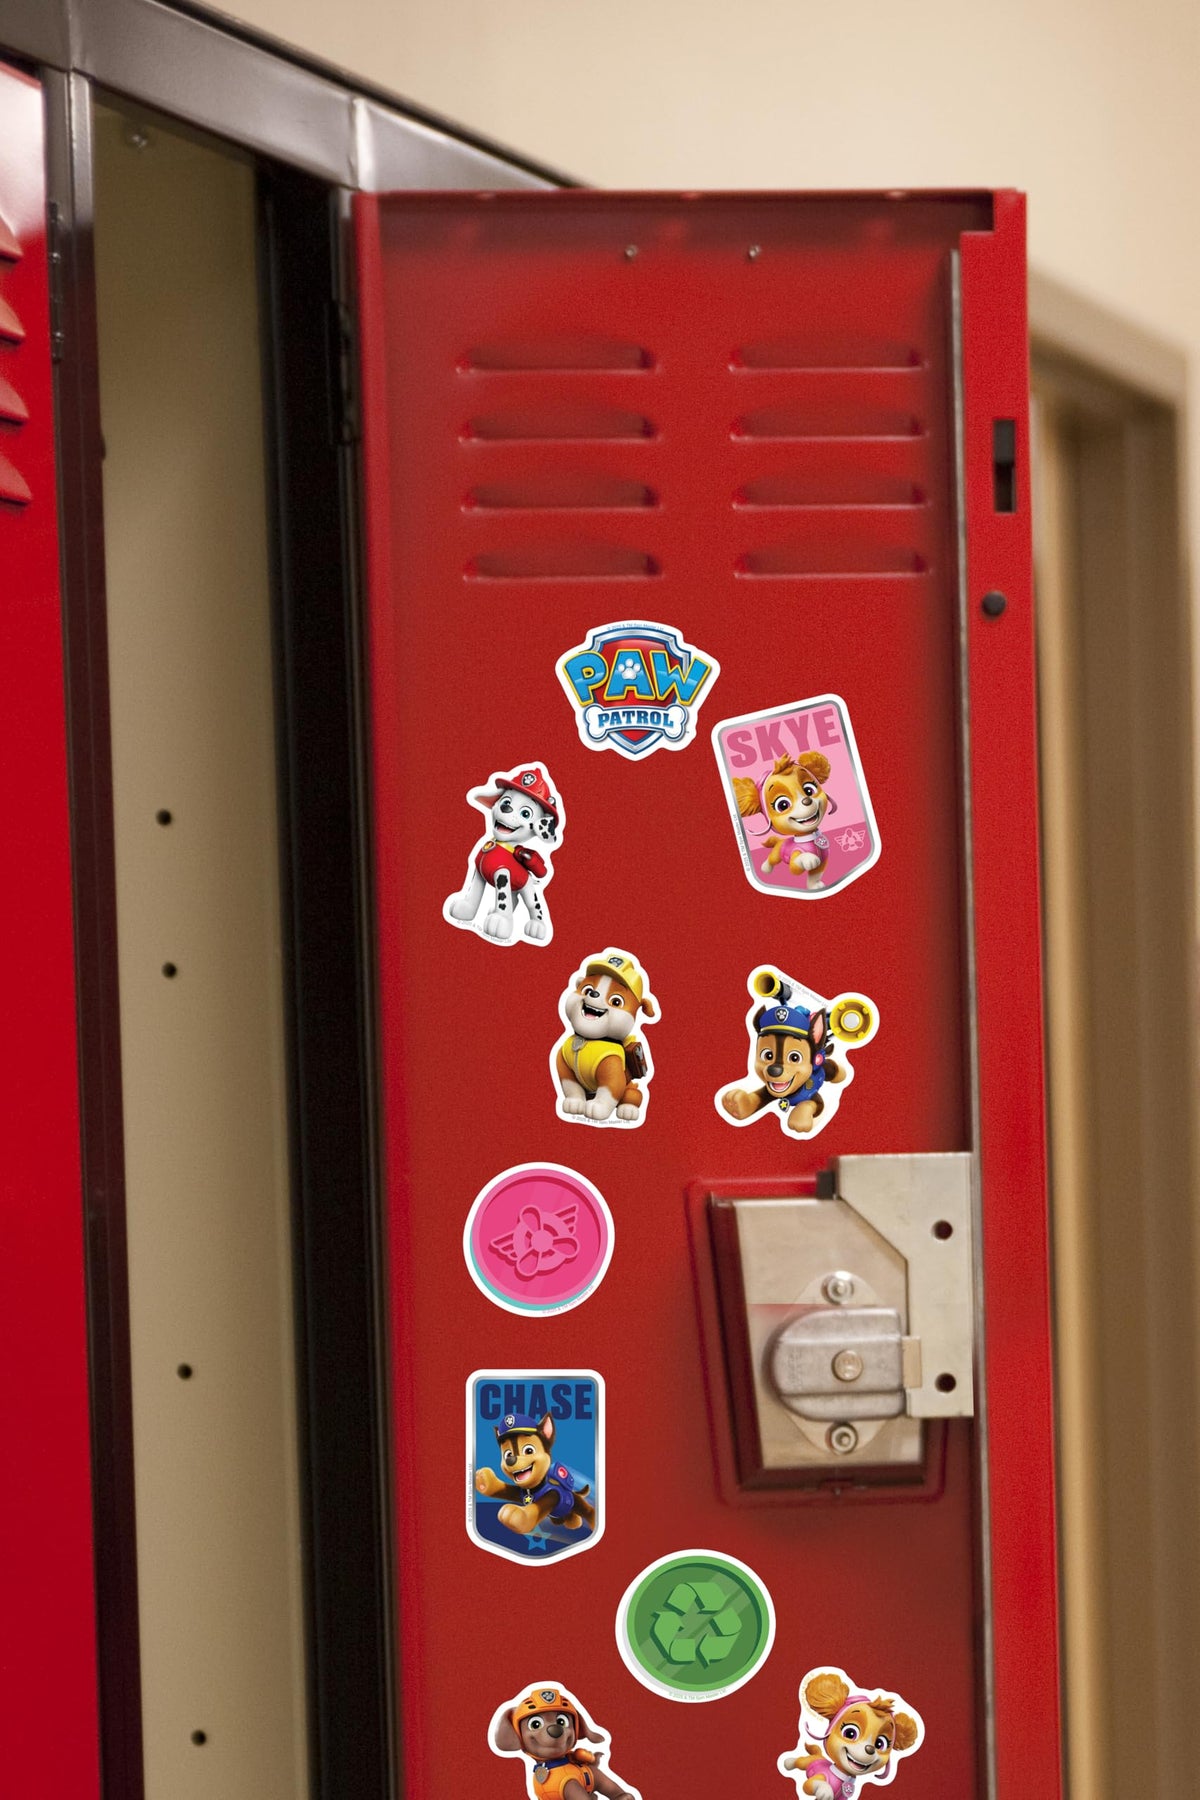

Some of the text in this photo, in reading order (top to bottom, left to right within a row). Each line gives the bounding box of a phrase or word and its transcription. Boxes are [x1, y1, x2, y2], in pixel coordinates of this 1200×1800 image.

[563, 648, 711, 707] PAW
[598, 710, 674, 728] PATROL
[726, 708, 841, 769] SKYE
[479, 1383, 593, 1421] CHASE
